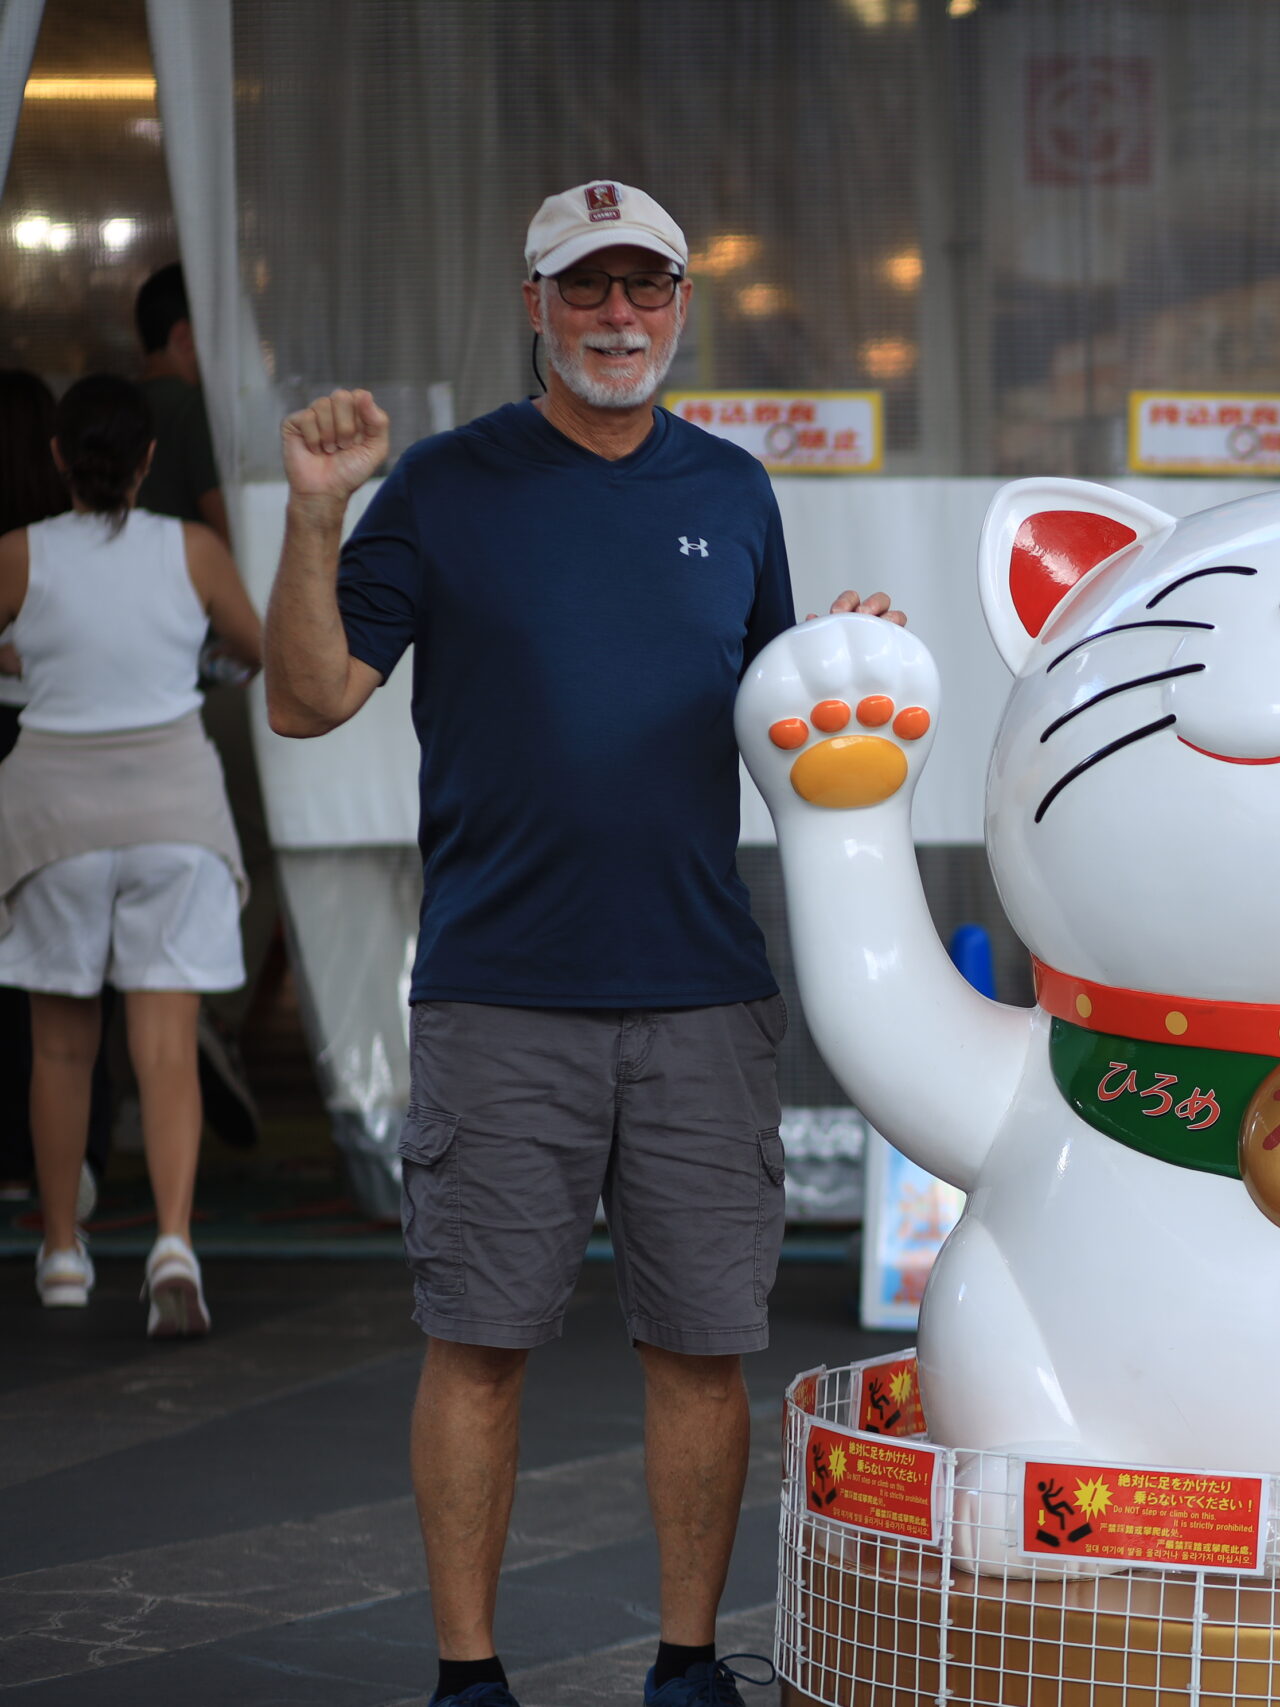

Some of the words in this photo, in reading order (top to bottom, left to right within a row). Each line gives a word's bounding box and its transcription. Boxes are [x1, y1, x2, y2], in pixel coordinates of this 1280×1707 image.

[1097, 1061, 1221, 1130] ひろめ
[848, 1441, 916, 1466] 絶対に足をかけたり
[1118, 1473, 1232, 1494] 絶対に足をかけたり
[1113, 1505, 1122, 1513] Do
[1124, 1506, 1140, 1515] NOT
[1142, 1508, 1157, 1517] step
[1169, 1510, 1188, 1519] climb
[1133, 1491, 1253, 1513] 乗らないでください！
[1173, 1519, 1178, 1527] It
[1181, 1520, 1187, 1528] is
[1190, 1520, 1214, 1531] strictly
